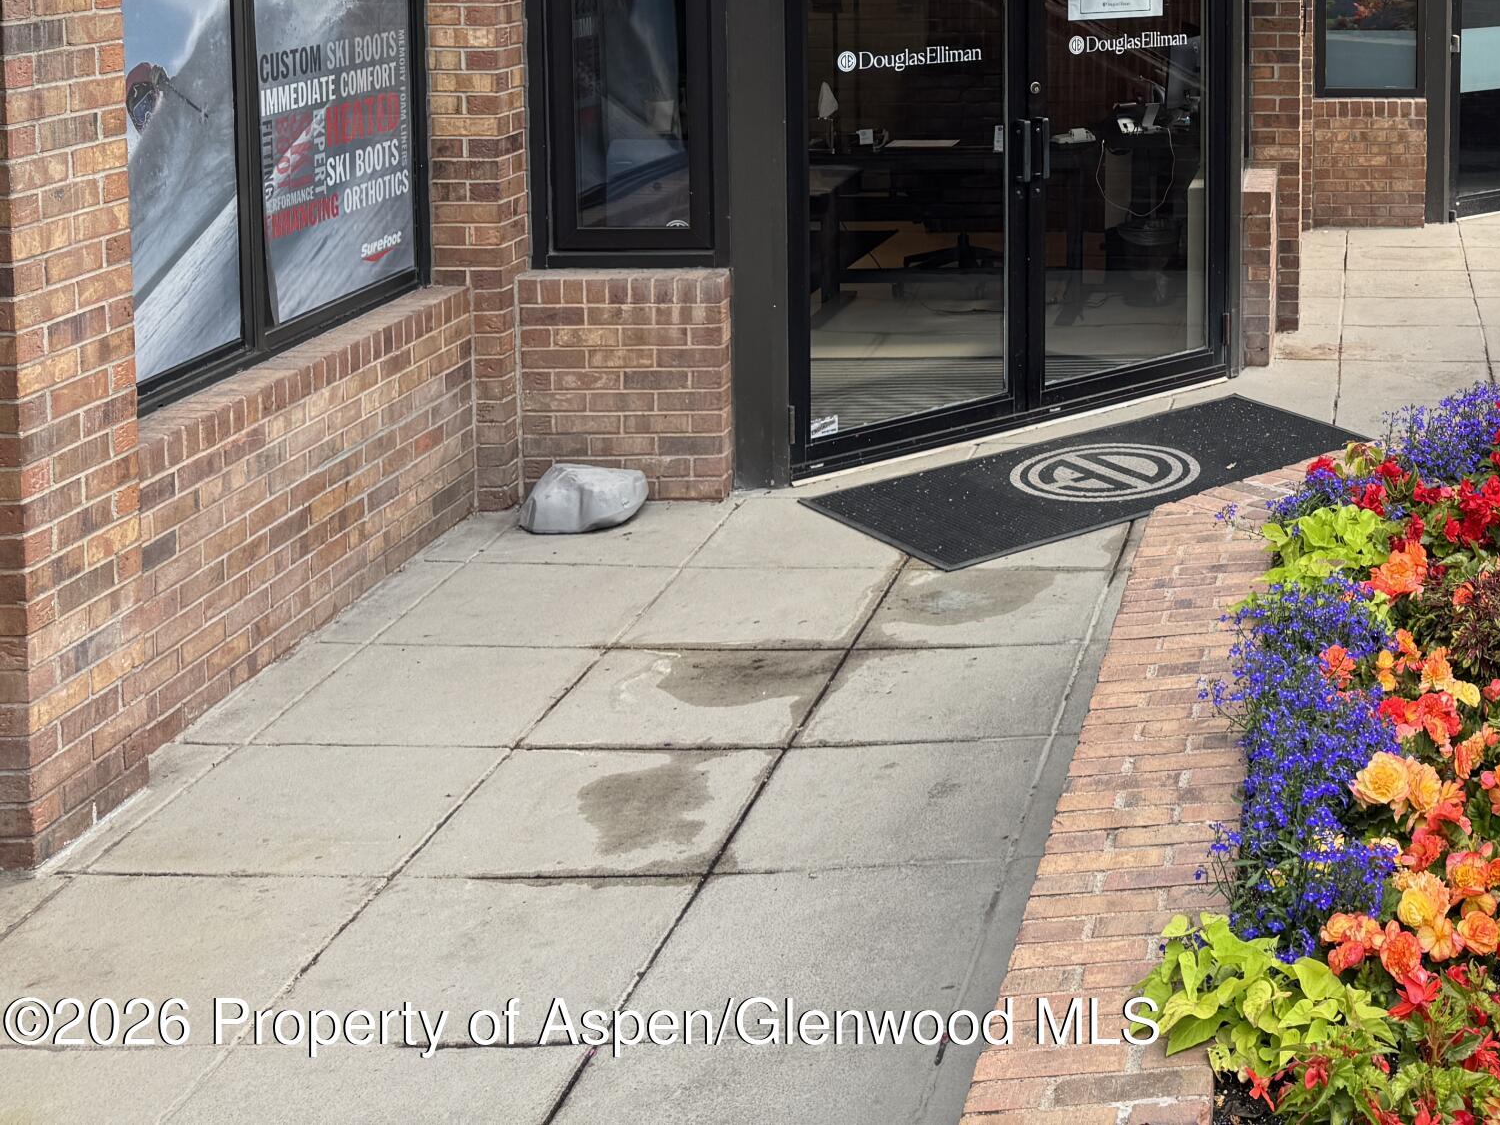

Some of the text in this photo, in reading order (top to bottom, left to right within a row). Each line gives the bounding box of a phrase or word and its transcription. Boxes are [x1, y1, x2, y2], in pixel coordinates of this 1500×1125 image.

[260, 31, 397, 84] CUSTOM SKI BOOTS
[858, 46, 982, 72] DouglasElliman
[1086, 31, 1188, 55] DouglasElliman
[261, 62, 397, 117] IMMEDIATE COMFORT
[326, 91, 400, 149] HEATED
[262, 119, 275, 202] FITTING
[313, 107, 327, 195] EXPERT
[327, 138, 399, 187] SKI BOOTS
[343, 169, 410, 213] ORTHOTICS
[361, 230, 402, 258] Surefoot
